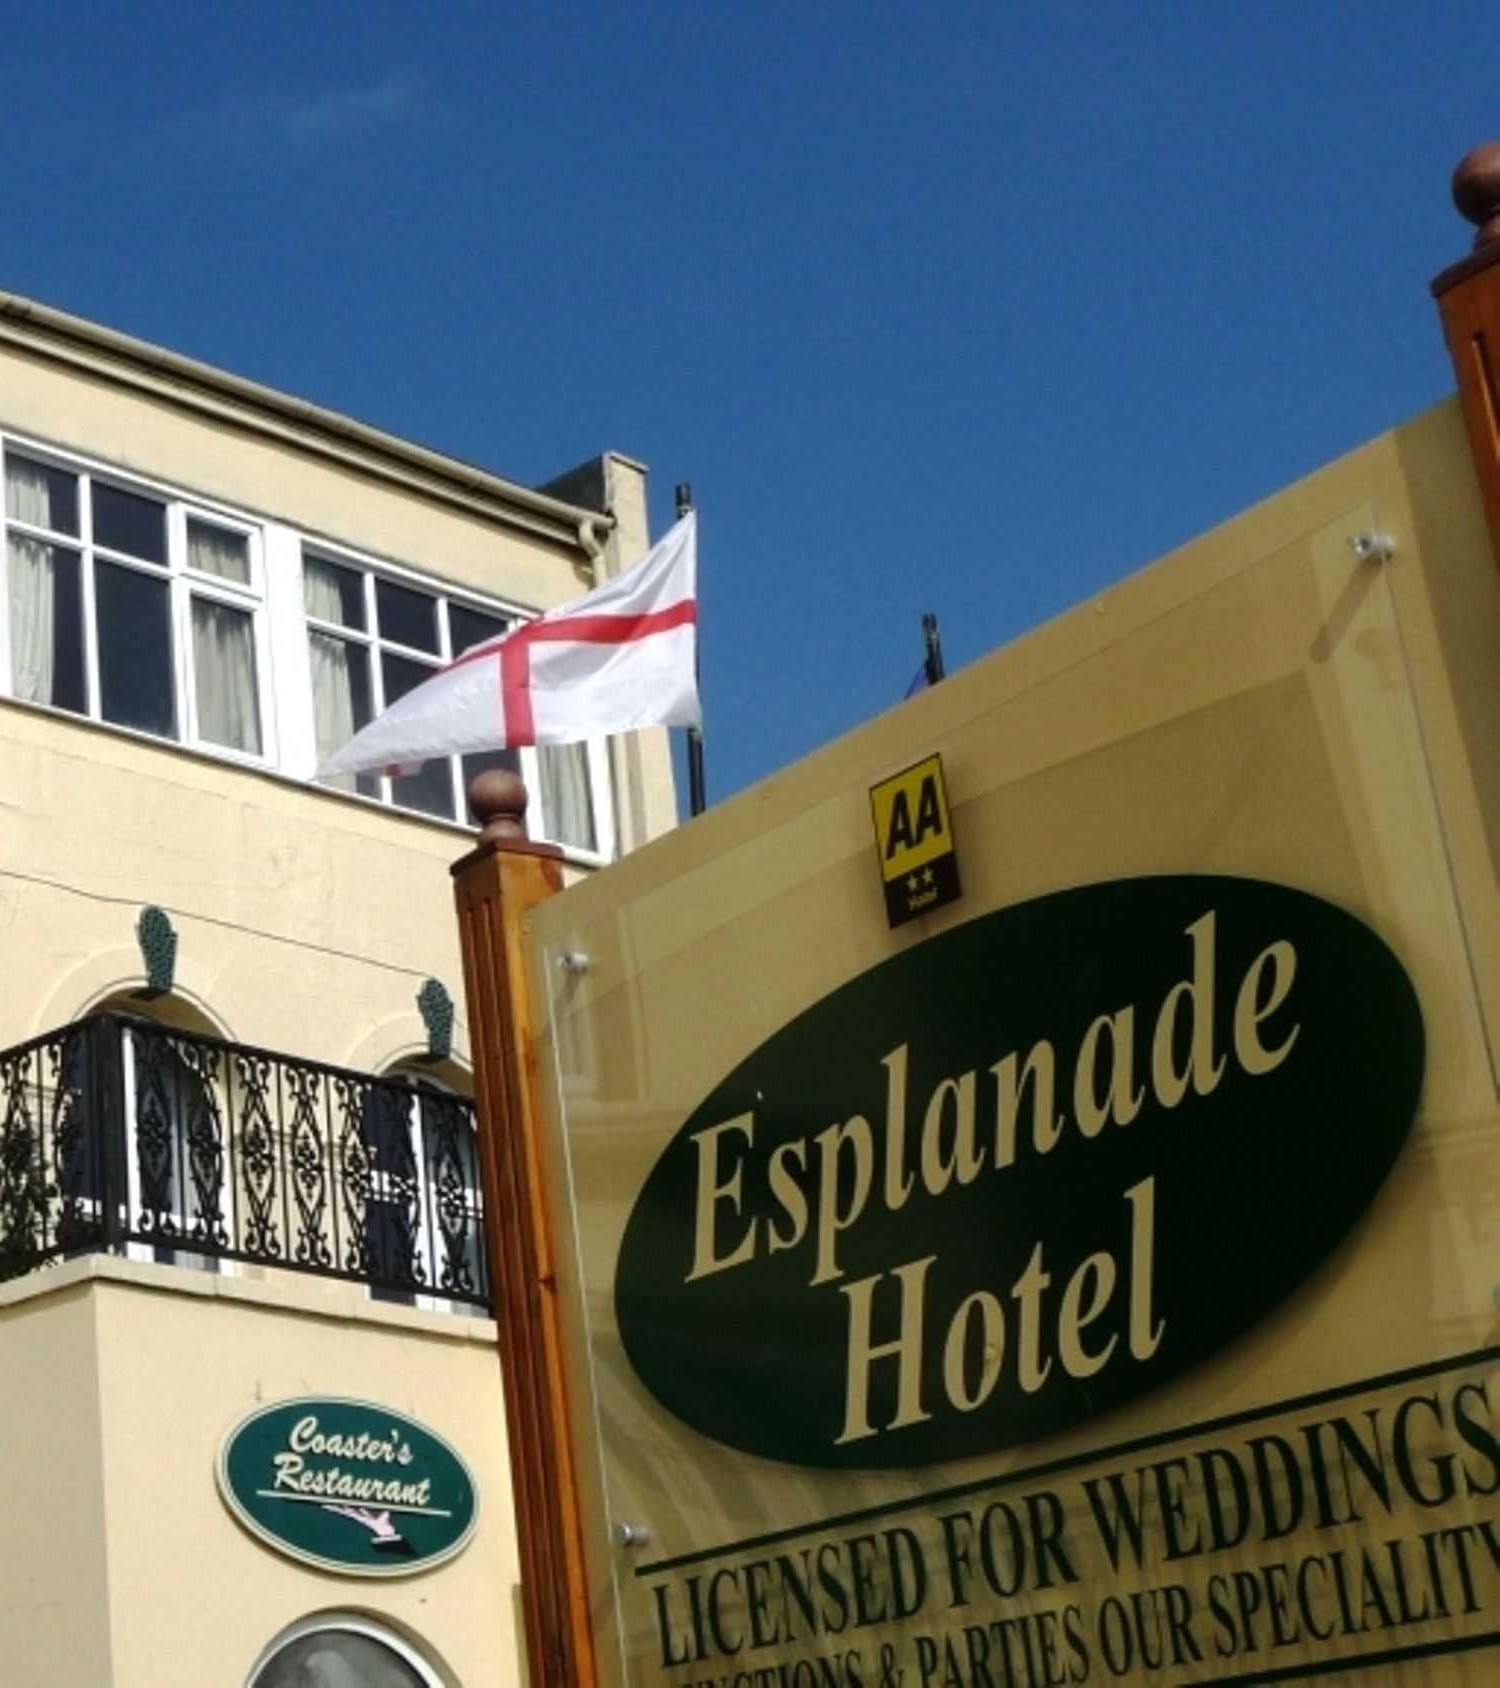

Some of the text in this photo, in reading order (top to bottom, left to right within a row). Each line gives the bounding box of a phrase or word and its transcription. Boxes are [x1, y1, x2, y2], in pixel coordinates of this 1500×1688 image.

[886, 775, 942, 861] AA
[684, 909, 1301, 1287] Esplanade
[835, 1175, 1166, 1445] Hotel
[273, 1451, 431, 1506] Restaurant
[288, 1415, 414, 1466] Coaster's
[652, 1381, 1500, 1669] LICENSED FOR WEDDINGS
[913, 1604, 1090, 1688] PARTIES
[1100, 1575, 1209, 1677] OUR
